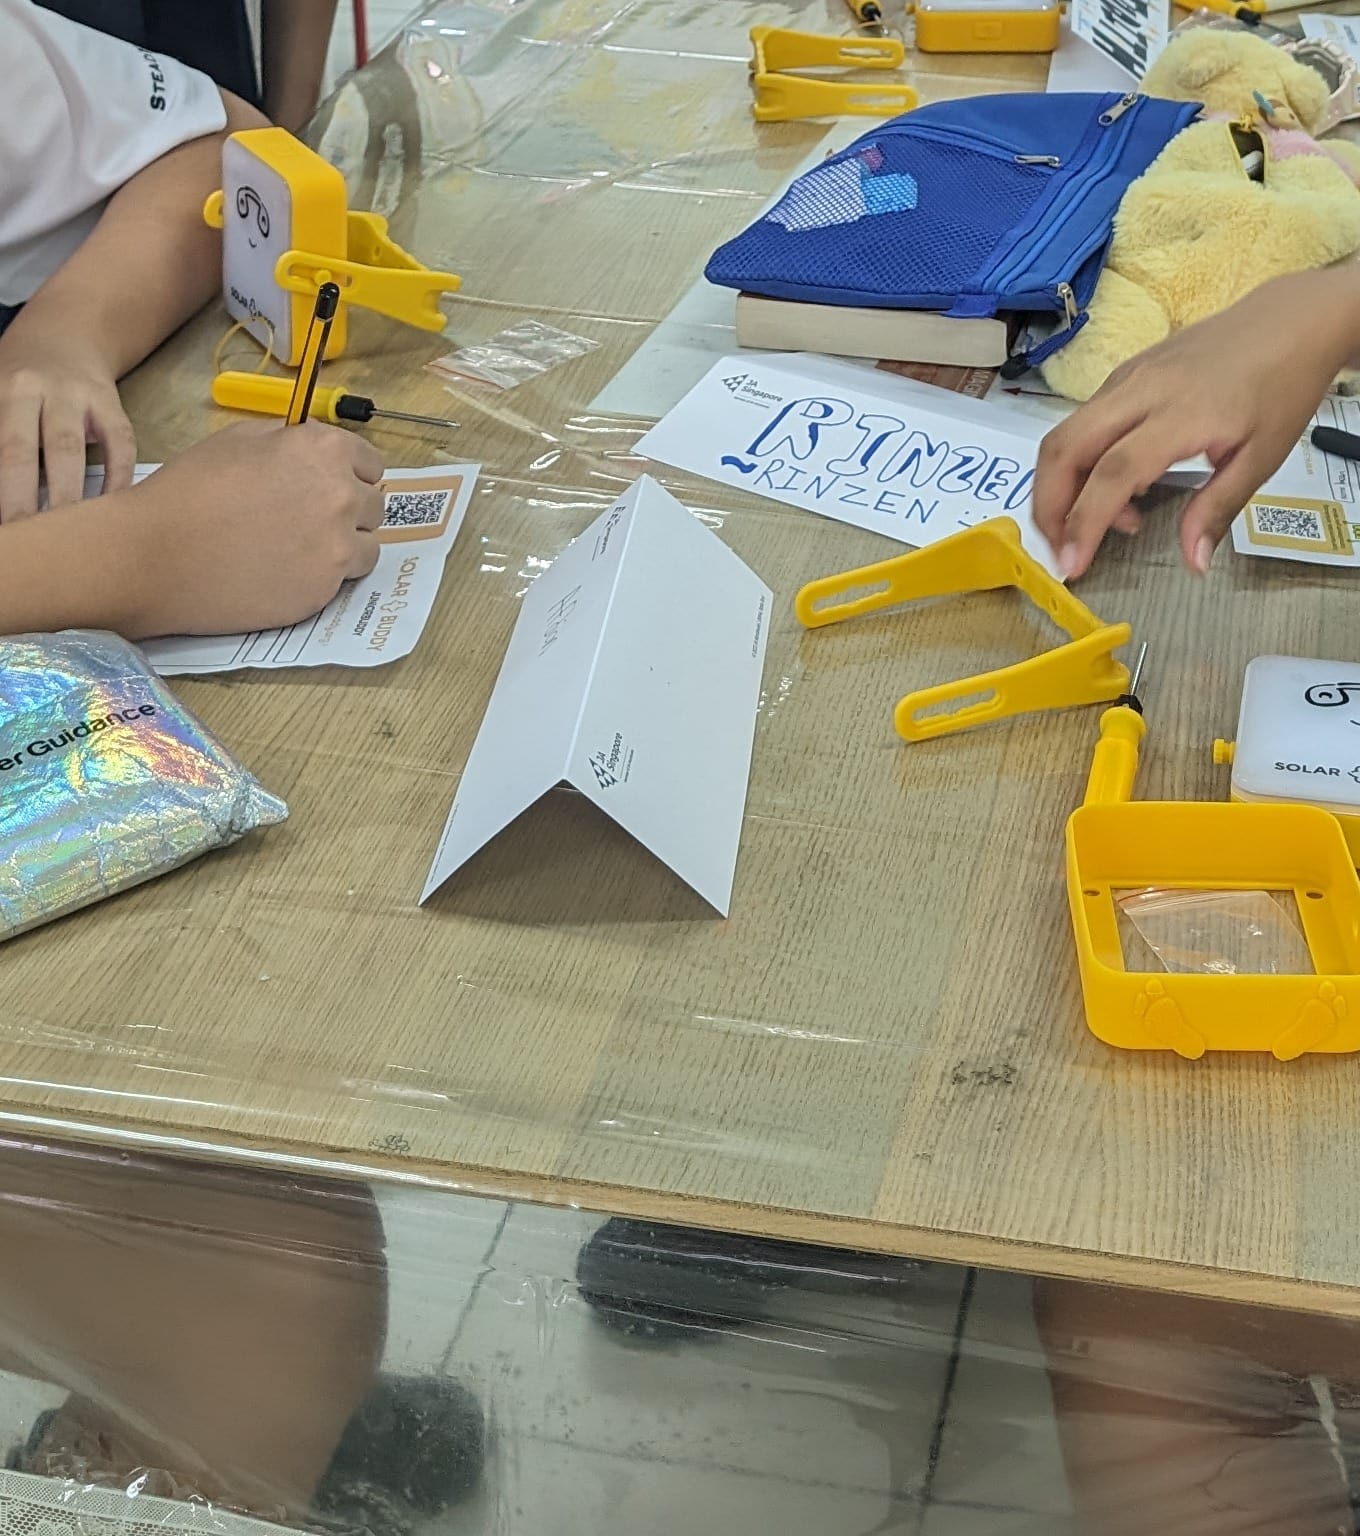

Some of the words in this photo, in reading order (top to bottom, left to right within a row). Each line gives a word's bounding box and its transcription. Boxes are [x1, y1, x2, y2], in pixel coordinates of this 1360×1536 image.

[740, 383, 784, 404] Singapore
[745, 396, 1036, 511] RINZE
[753, 458, 939, 525] RINZEN
[391, 555, 419, 598] SOLAR
[369, 614, 397, 652] BUDDY
[27, 701, 156, 759] Guidance
[605, 731, 623, 772] Singapore
[1273, 760, 1341, 778] SOLAR
